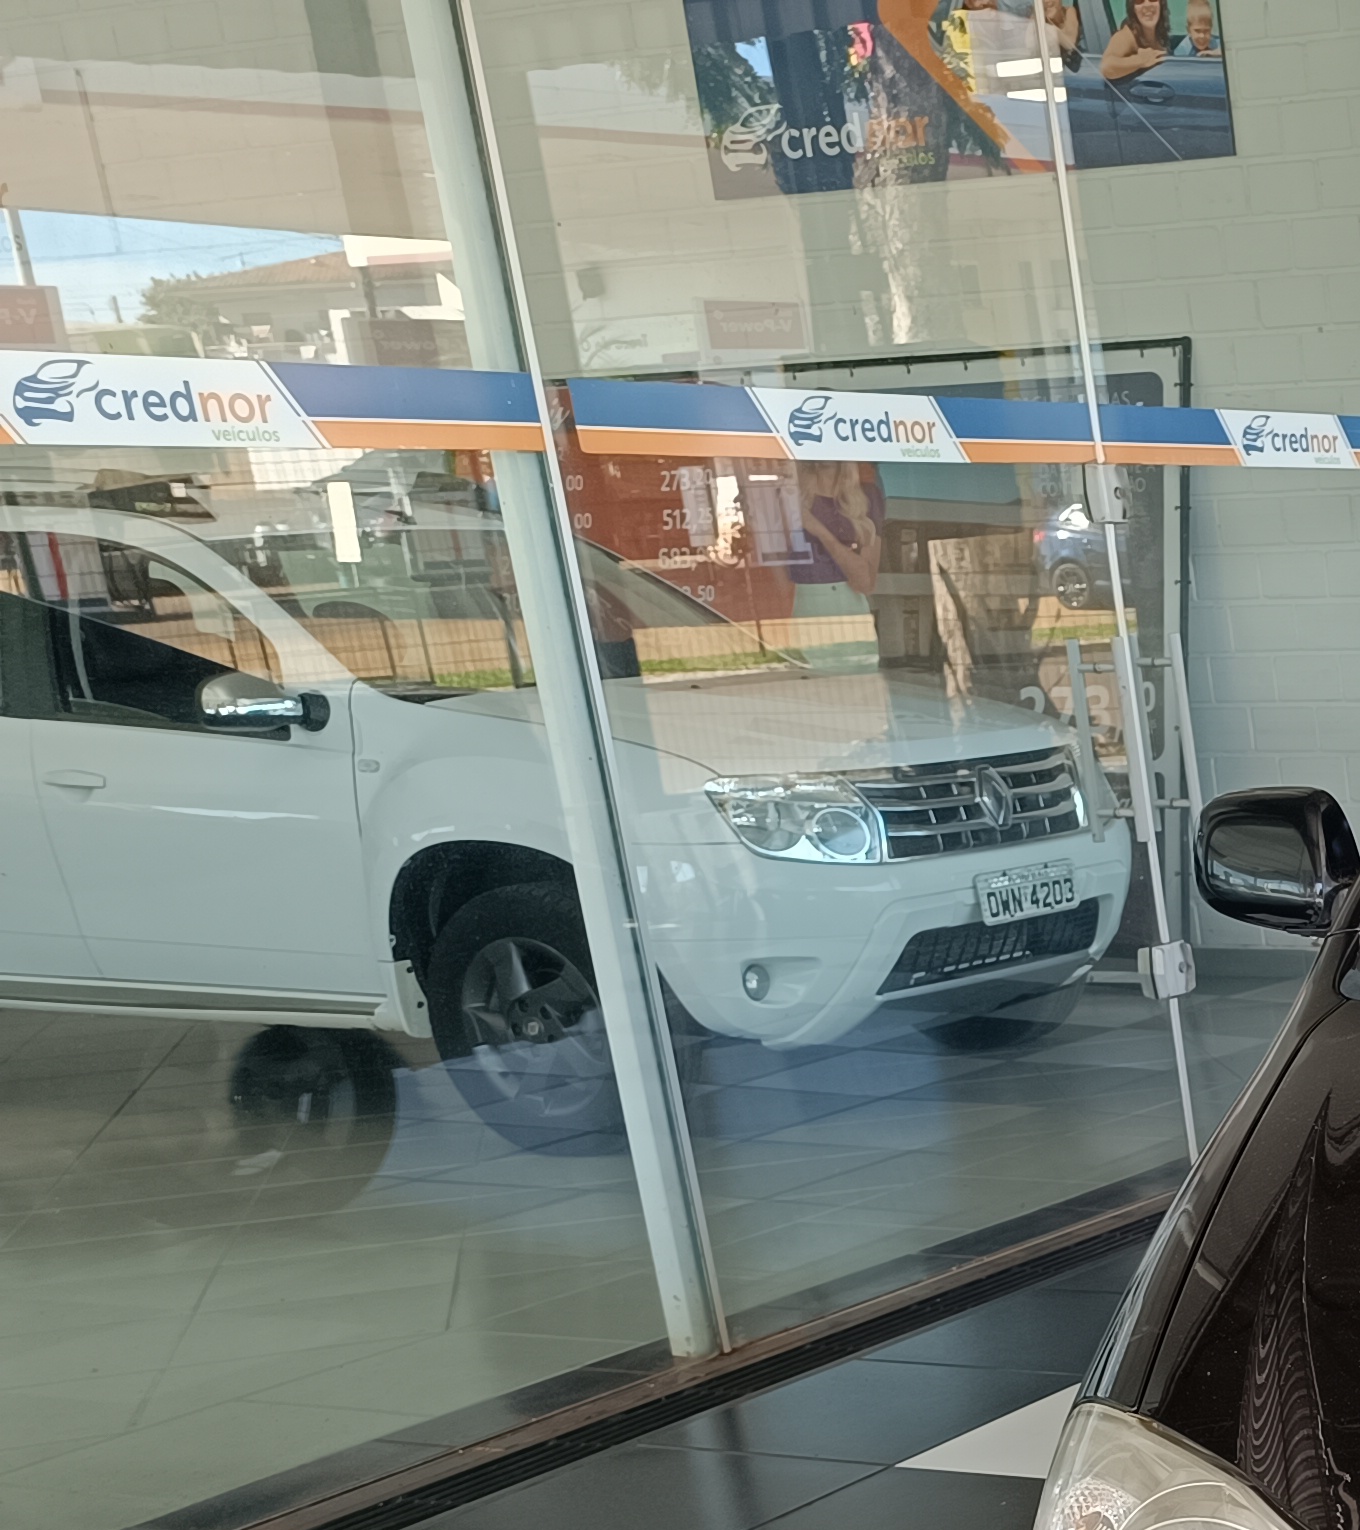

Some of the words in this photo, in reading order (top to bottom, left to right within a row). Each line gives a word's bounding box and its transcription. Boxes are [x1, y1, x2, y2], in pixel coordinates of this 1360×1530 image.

[94, 380, 272, 423] crednor
[834, 411, 936, 443] crednor
[1271, 427, 1339, 453] crednor
[1030, 878, 1075, 910] 4203
